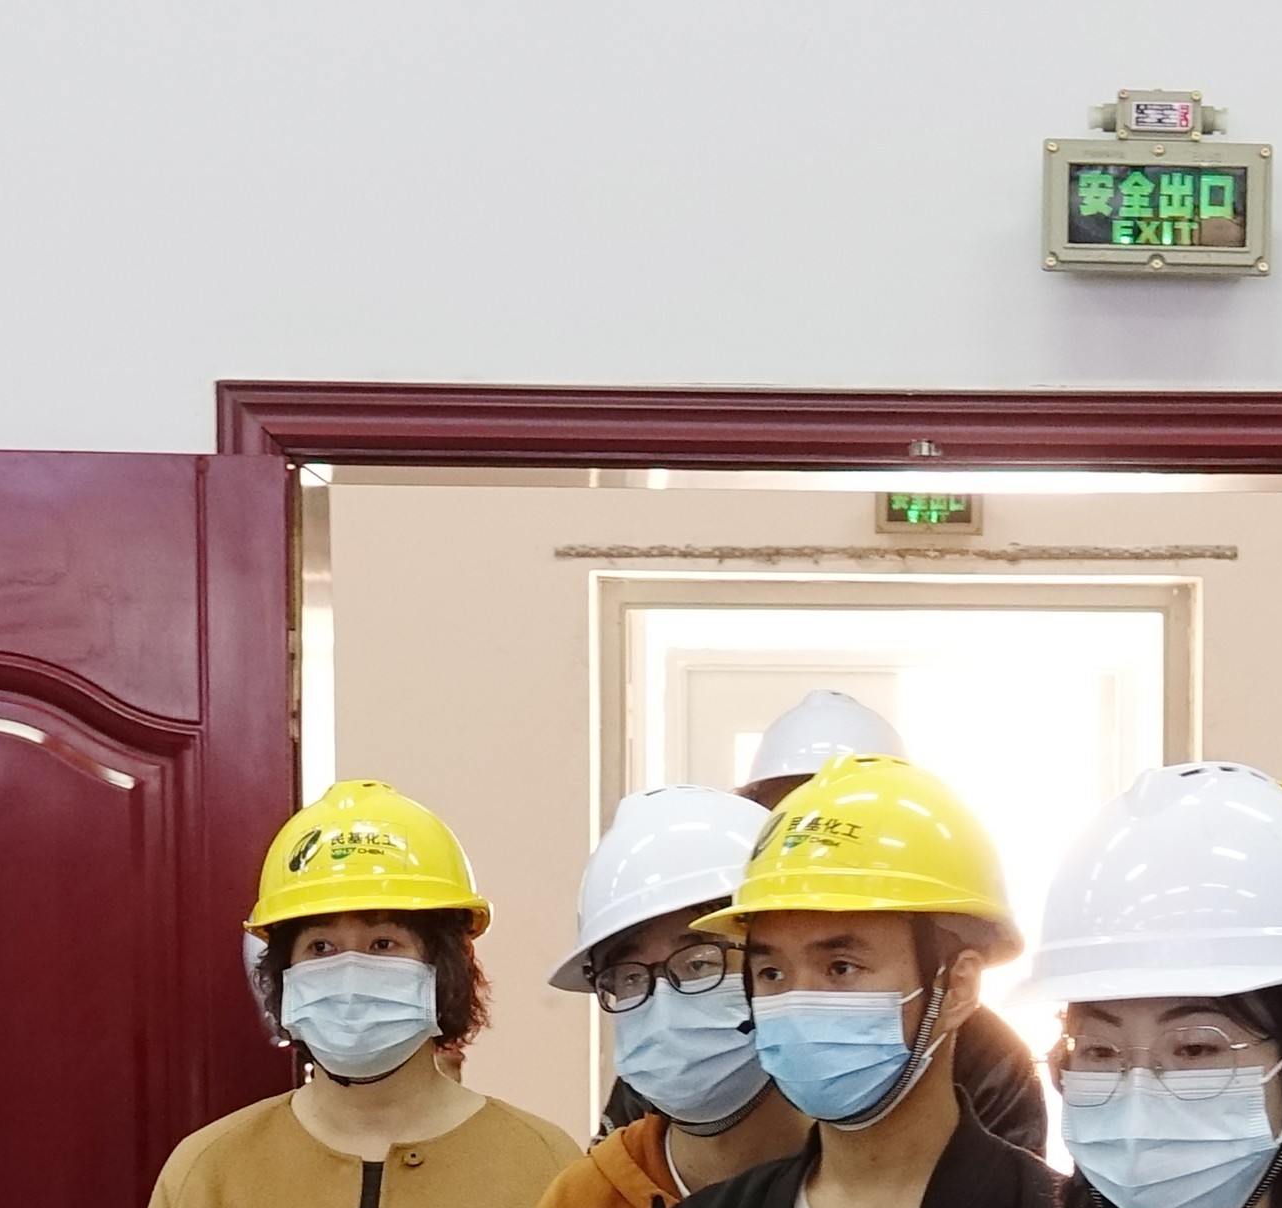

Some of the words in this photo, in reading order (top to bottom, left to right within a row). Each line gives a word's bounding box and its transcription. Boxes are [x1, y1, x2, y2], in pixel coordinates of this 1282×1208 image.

[1078, 171, 1235, 219] 安全出口
[1112, 219, 1199, 245] EXIT
